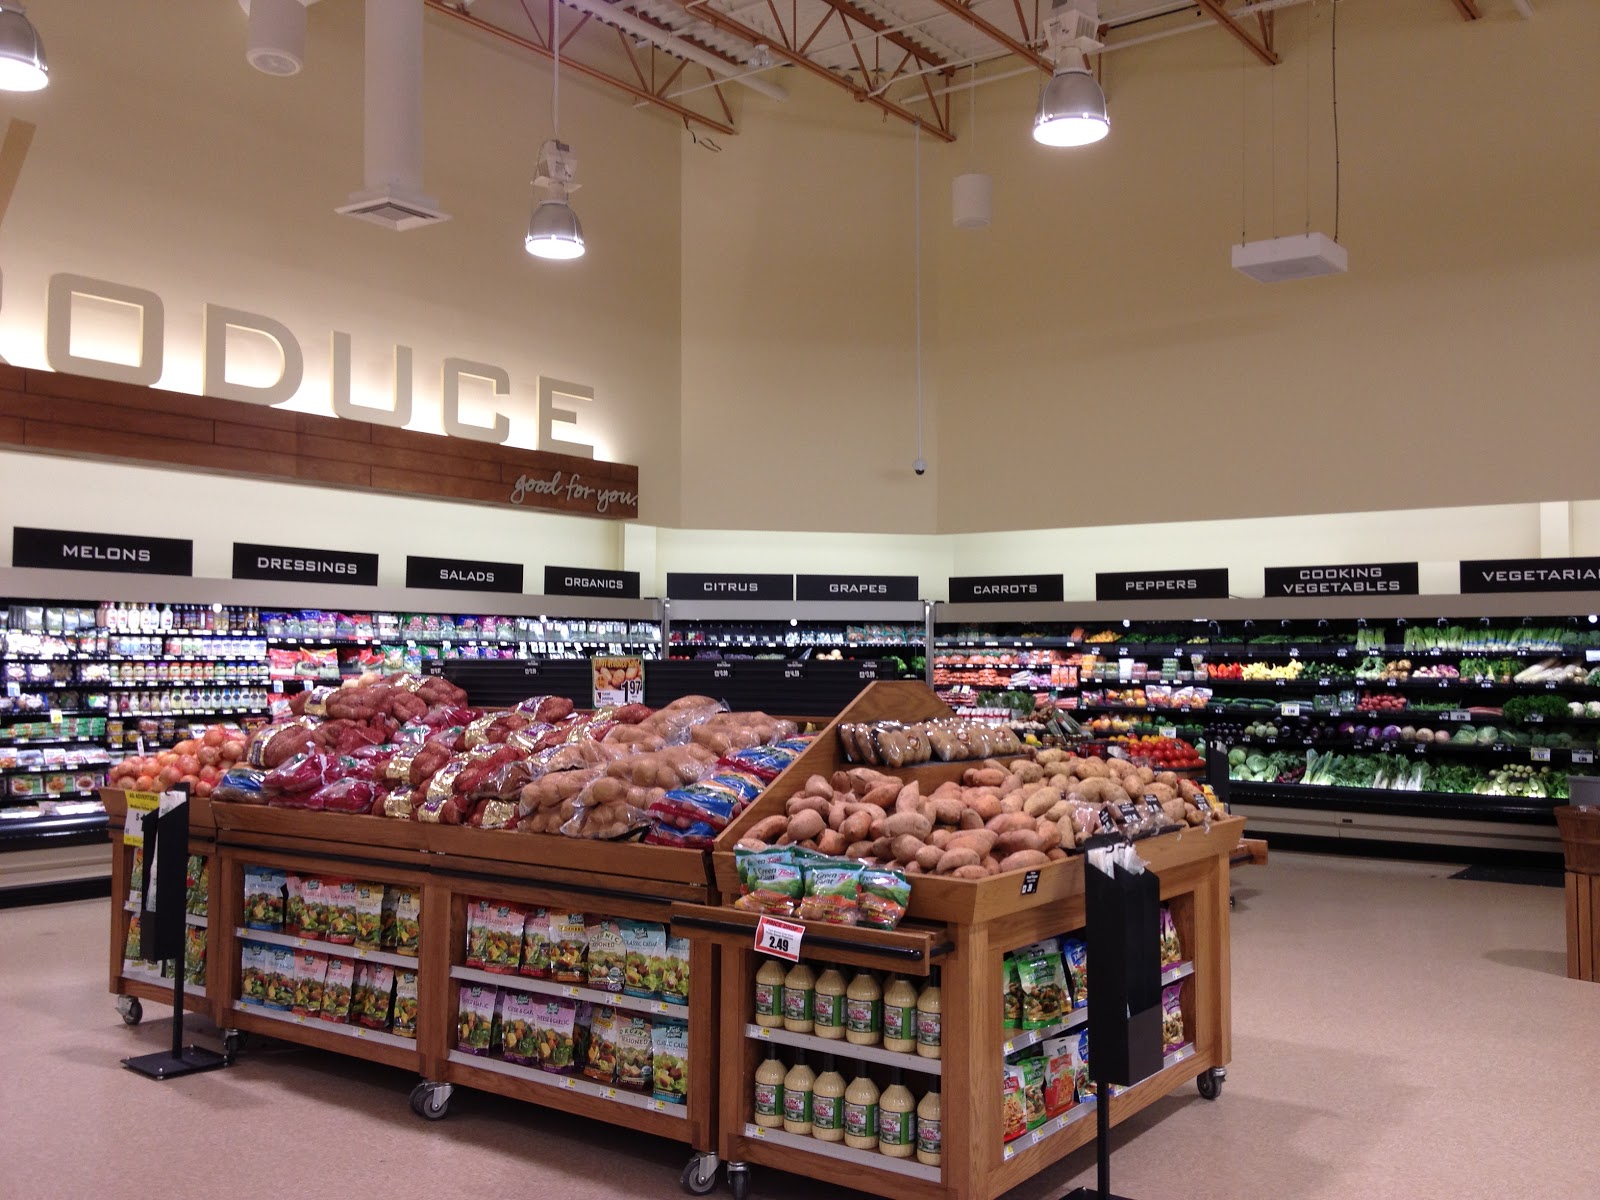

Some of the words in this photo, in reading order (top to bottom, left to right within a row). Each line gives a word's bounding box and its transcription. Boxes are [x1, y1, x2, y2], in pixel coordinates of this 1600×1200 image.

[0, 264, 595, 461] ODUCE
[510, 471, 563, 504] good
[566, 473, 595, 501] for
[597, 489, 639, 513] you.
[62, 543, 151, 563] MELONS
[257, 556, 358, 575] DRESSINGS
[439, 569, 495, 583] SALADS
[1299, 567, 1383, 580] COOKING
[1481, 568, 1600, 582] VEGETARIA
[564, 577, 624, 590] ORGANICS
[703, 582, 759, 592] CITRUS
[829, 583, 888, 594] GRAPES
[973, 584, 1038, 595] CARROTS
[1125, 579, 1198, 591] PEPPERS
[1282, 580, 1401, 594] VEGETABLES
[769, 936, 789, 952] 2.49
